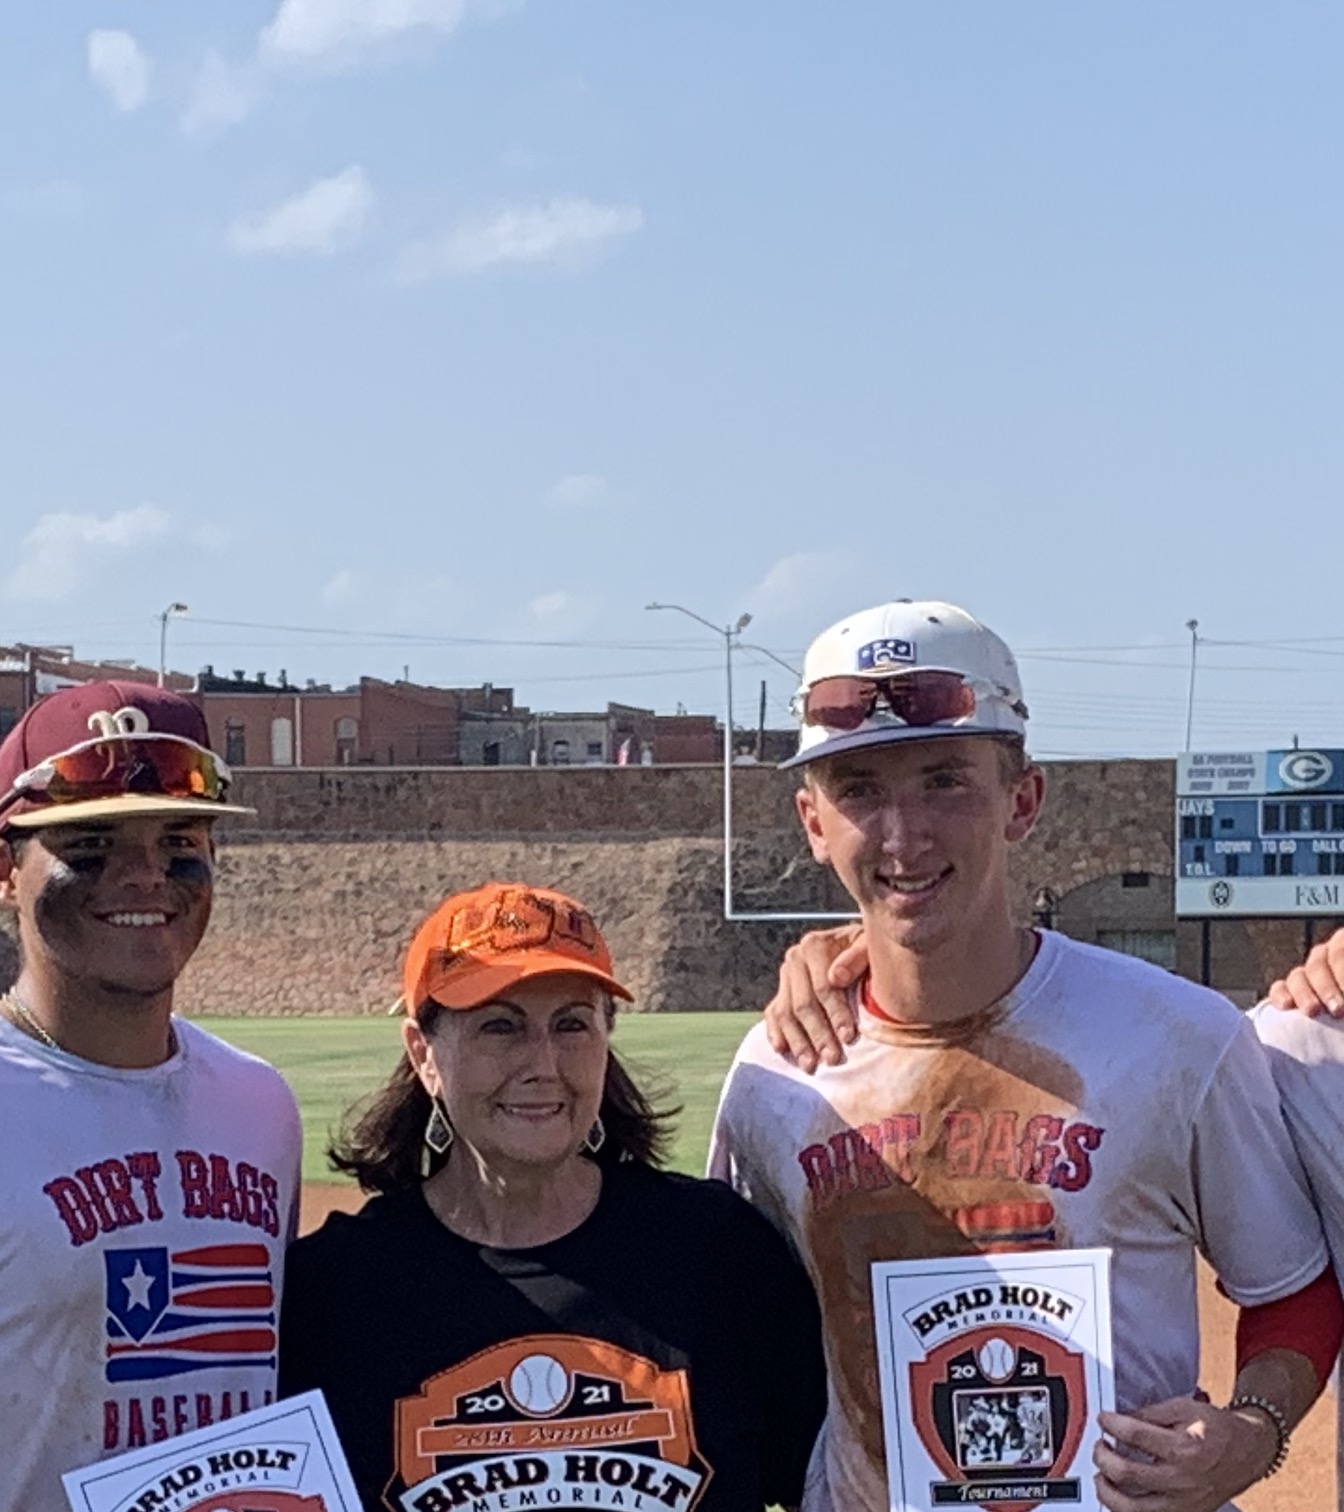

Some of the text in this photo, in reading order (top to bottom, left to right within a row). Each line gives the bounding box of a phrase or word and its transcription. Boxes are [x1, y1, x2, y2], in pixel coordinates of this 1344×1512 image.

[1179, 799, 1215, 816] JAYS
[1295, 884, 1339, 906] F&M
[945, 1110, 1106, 1193] BAGS
[43, 1150, 280, 1246] DIRT BAGS
[912, 1284, 1074, 1338] BRAD HOLT
[946, 1309, 1049, 1331] MEMORIAL
[950, 1362, 1039, 1379] 20 21
[465, 1385, 611, 1414] 20 21
[103, 1389, 274, 1451] BASEBA
[207, 1448, 297, 1476] HOLT
[564, 1455, 692, 1509] HOLT
[958, 1483, 1049, 1501] Tournament
